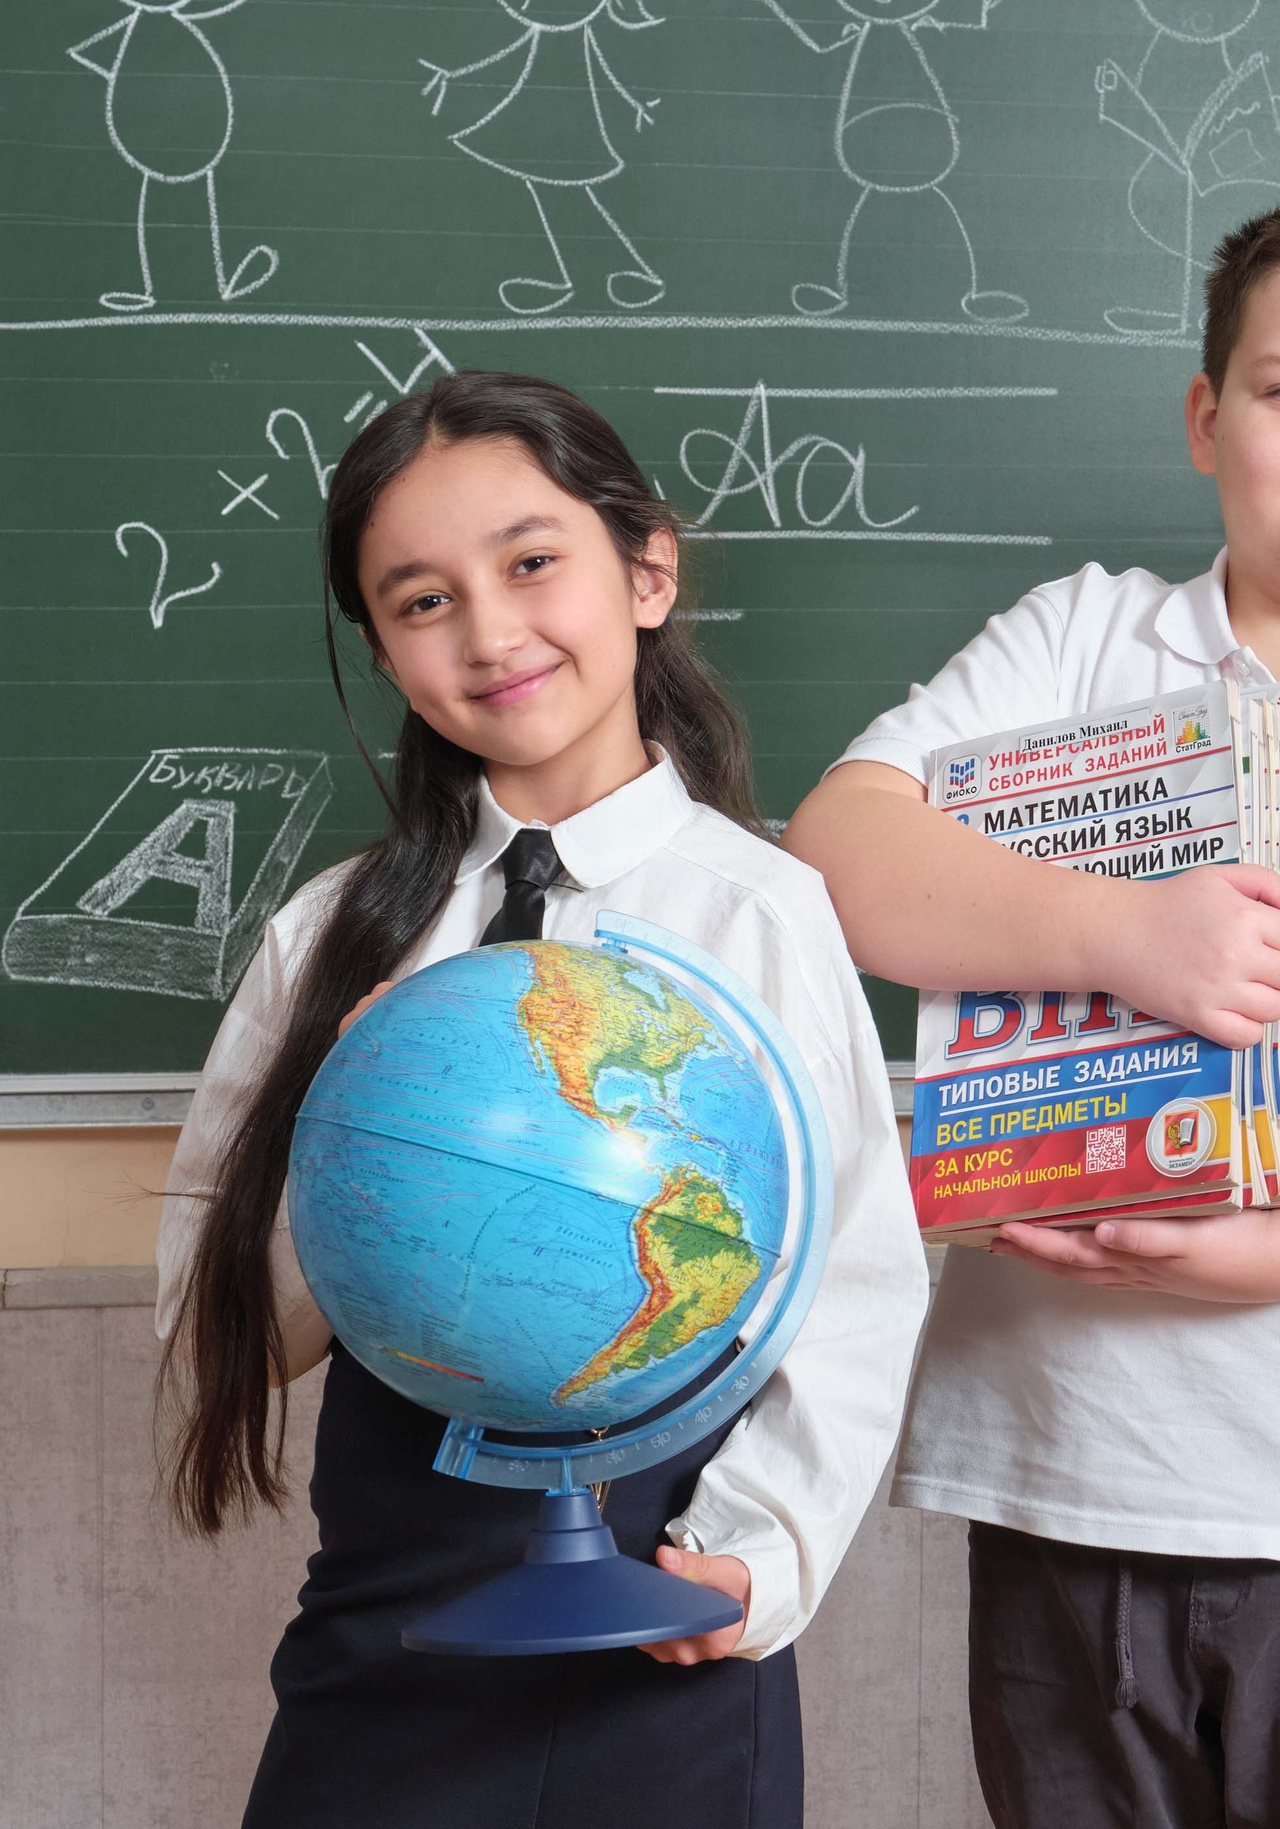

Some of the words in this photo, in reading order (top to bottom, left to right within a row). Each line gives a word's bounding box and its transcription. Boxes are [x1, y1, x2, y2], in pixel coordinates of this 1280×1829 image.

[1021, 731, 1076, 752] Данилов
[1079, 720, 1128, 739] Михаил
[1175, 738, 1212, 754] СтатГрад
[988, 762, 1073, 792] СБОРНИК
[1085, 737, 1167, 772] ЗАДАНИЙ
[946, 785, 978, 800] ФИОКО
[984, 777, 1169, 834] МАТЕМАТИКА
[1115, 806, 1193, 843] ЯЗЫК
[1171, 837, 1224, 868] МИР
[939, 1065, 1061, 1107] ТИПОВЫЕ
[1073, 1042, 1199, 1083] ЗАДАНИЯ
[936, 1117, 983, 1146] ВСЕ
[990, 1092, 1127, 1136] ПРЕДМЕТЫ
[934, 1157, 959, 1178] ЗА
[964, 1148, 1013, 1173] КУРС
[934, 1170, 1021, 1199] НАЧАЛЬНОЙ
[1025, 1162, 1081, 1184] ШКОЛЫ
